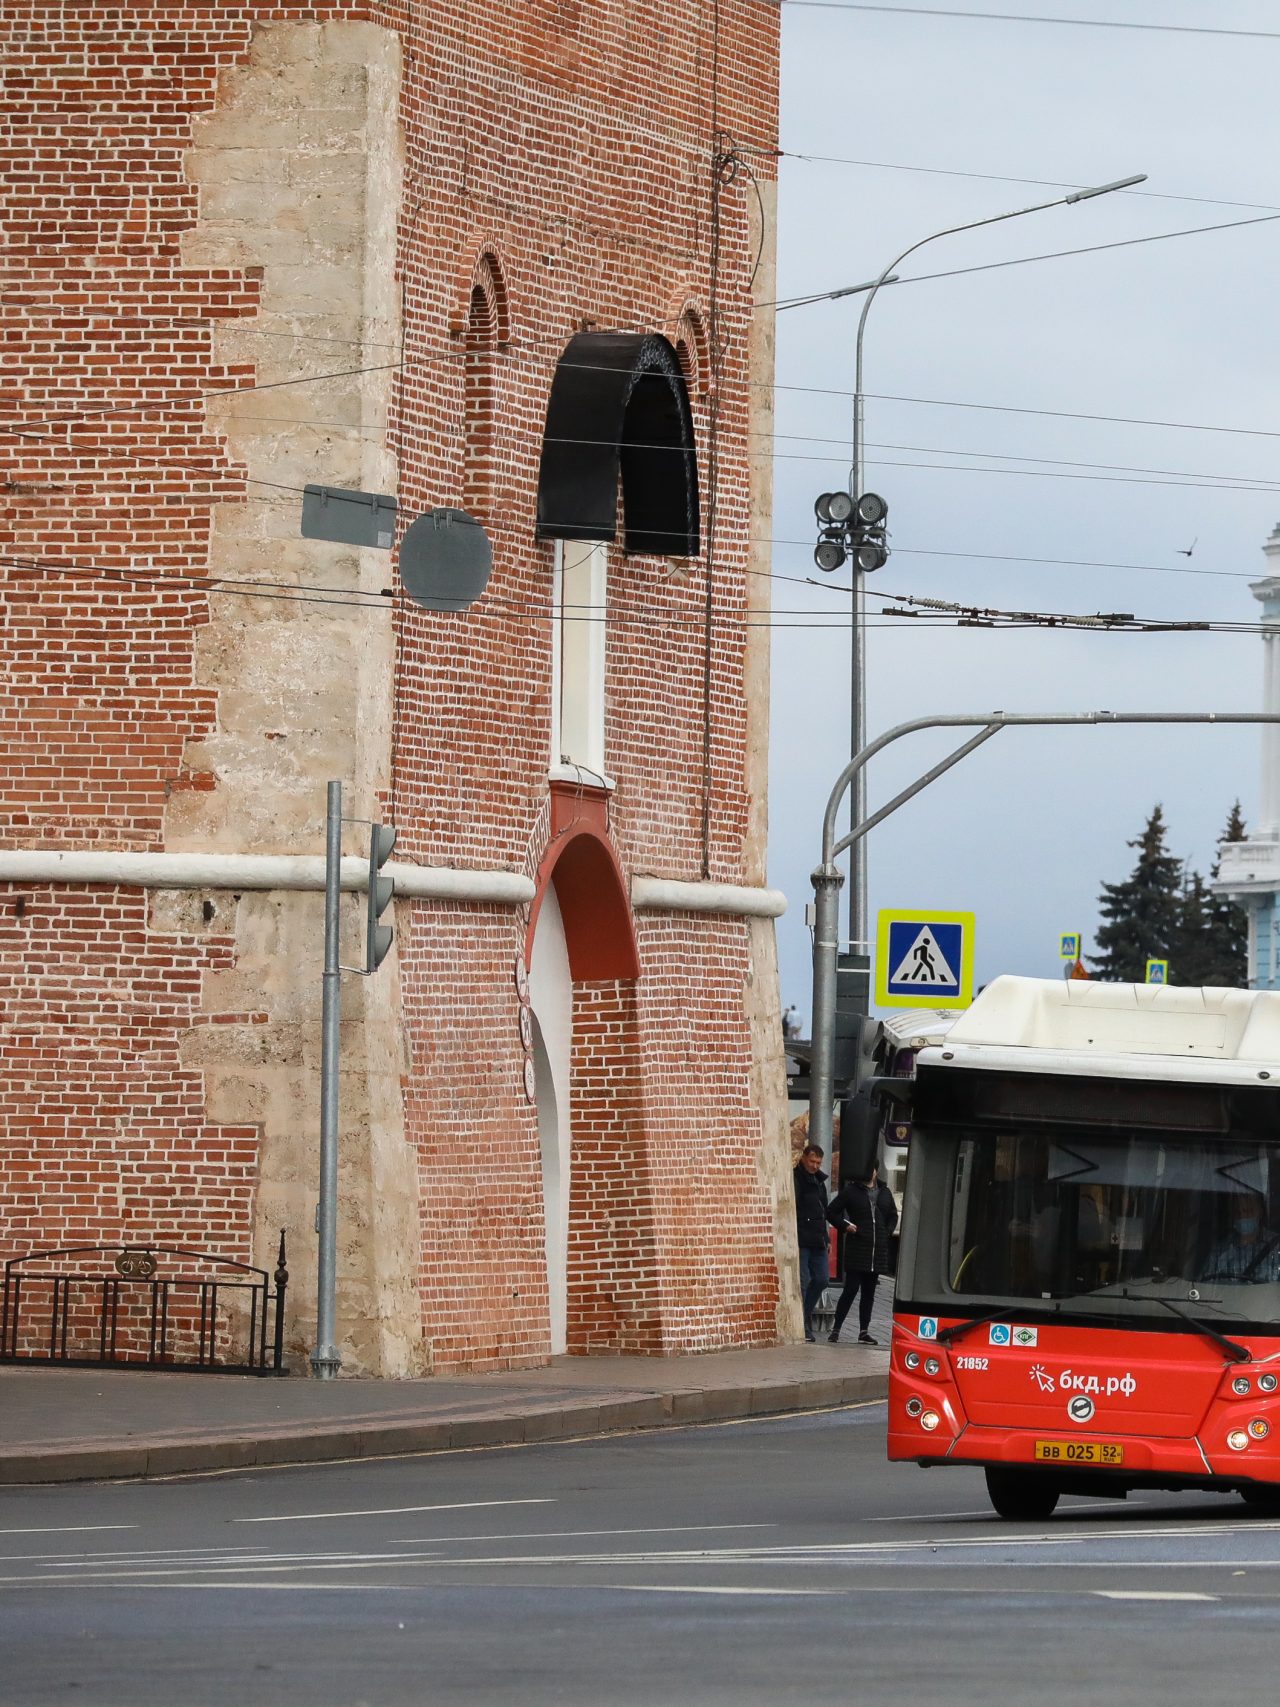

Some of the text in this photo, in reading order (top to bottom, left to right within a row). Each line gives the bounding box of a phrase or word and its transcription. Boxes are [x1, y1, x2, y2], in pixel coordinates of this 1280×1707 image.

[956, 1356, 989, 1370] 21852
[1059, 1369, 1137, 1397] бкд.рф
[1066, 1444, 1094, 1460] 025
[1102, 1445, 1117, 1457] 52
